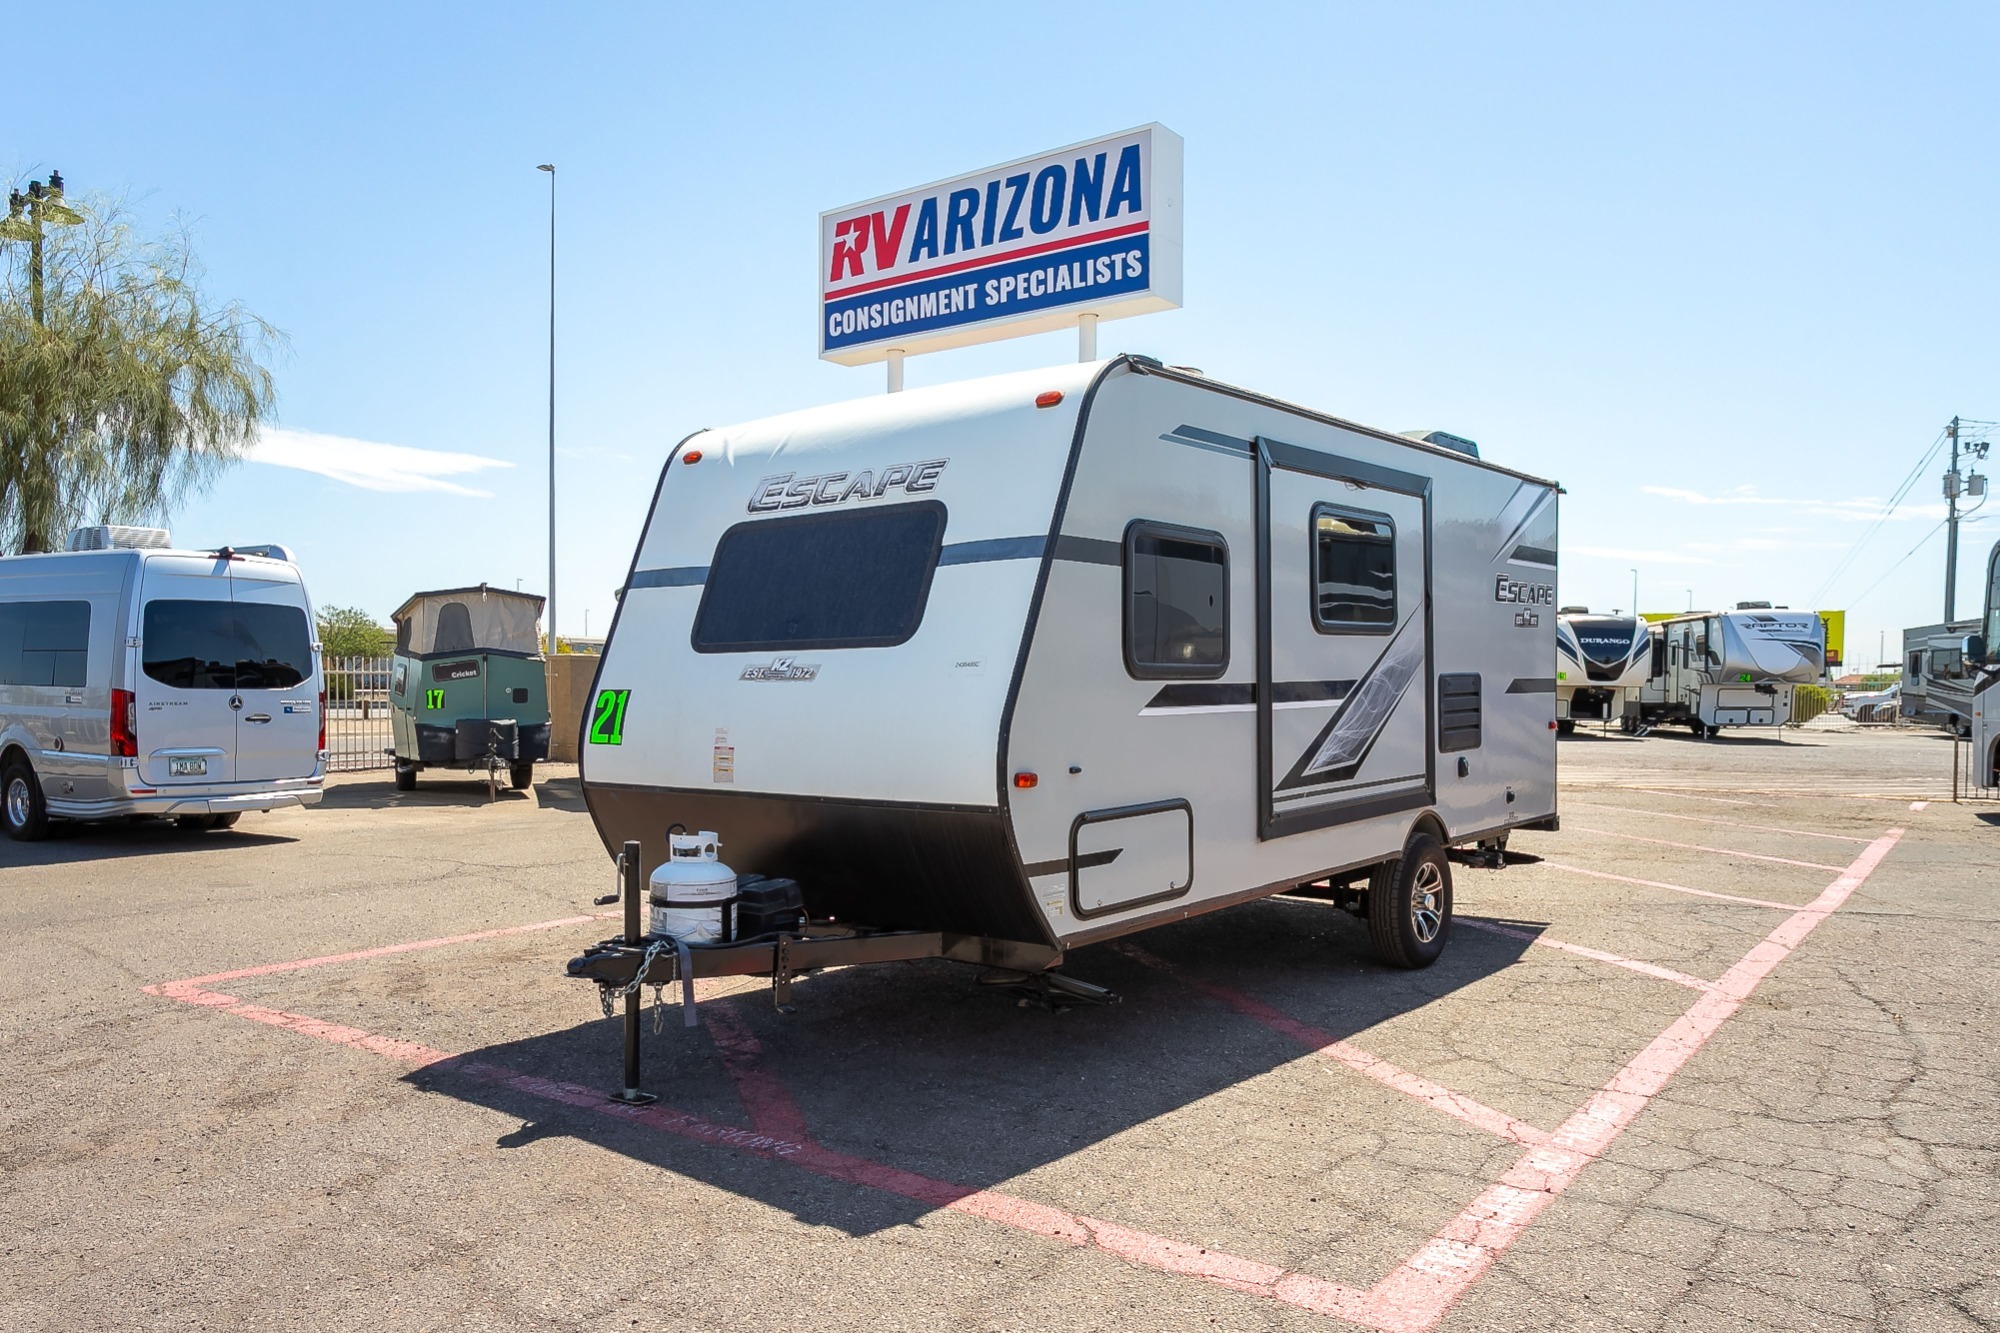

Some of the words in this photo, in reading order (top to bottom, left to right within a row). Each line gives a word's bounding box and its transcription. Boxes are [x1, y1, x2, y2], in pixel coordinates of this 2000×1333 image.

[829, 203, 912, 282] RV
[907, 143, 1142, 263] ARIZONA
[829, 283, 978, 337] CONSIGNMENT
[984, 249, 1142, 306] SPECIALISTS
[747, 458, 950, 514] ESCAPE
[1494, 573, 1554, 606] ESCAPE
[1740, 622, 1810, 630] RAPTOR
[451, 670, 477, 678] Cricket
[771, 658, 793, 671] KZ
[790, 668, 814, 679] 1972
[427, 689, 444, 709] 17
[590, 689, 630, 744] 21
